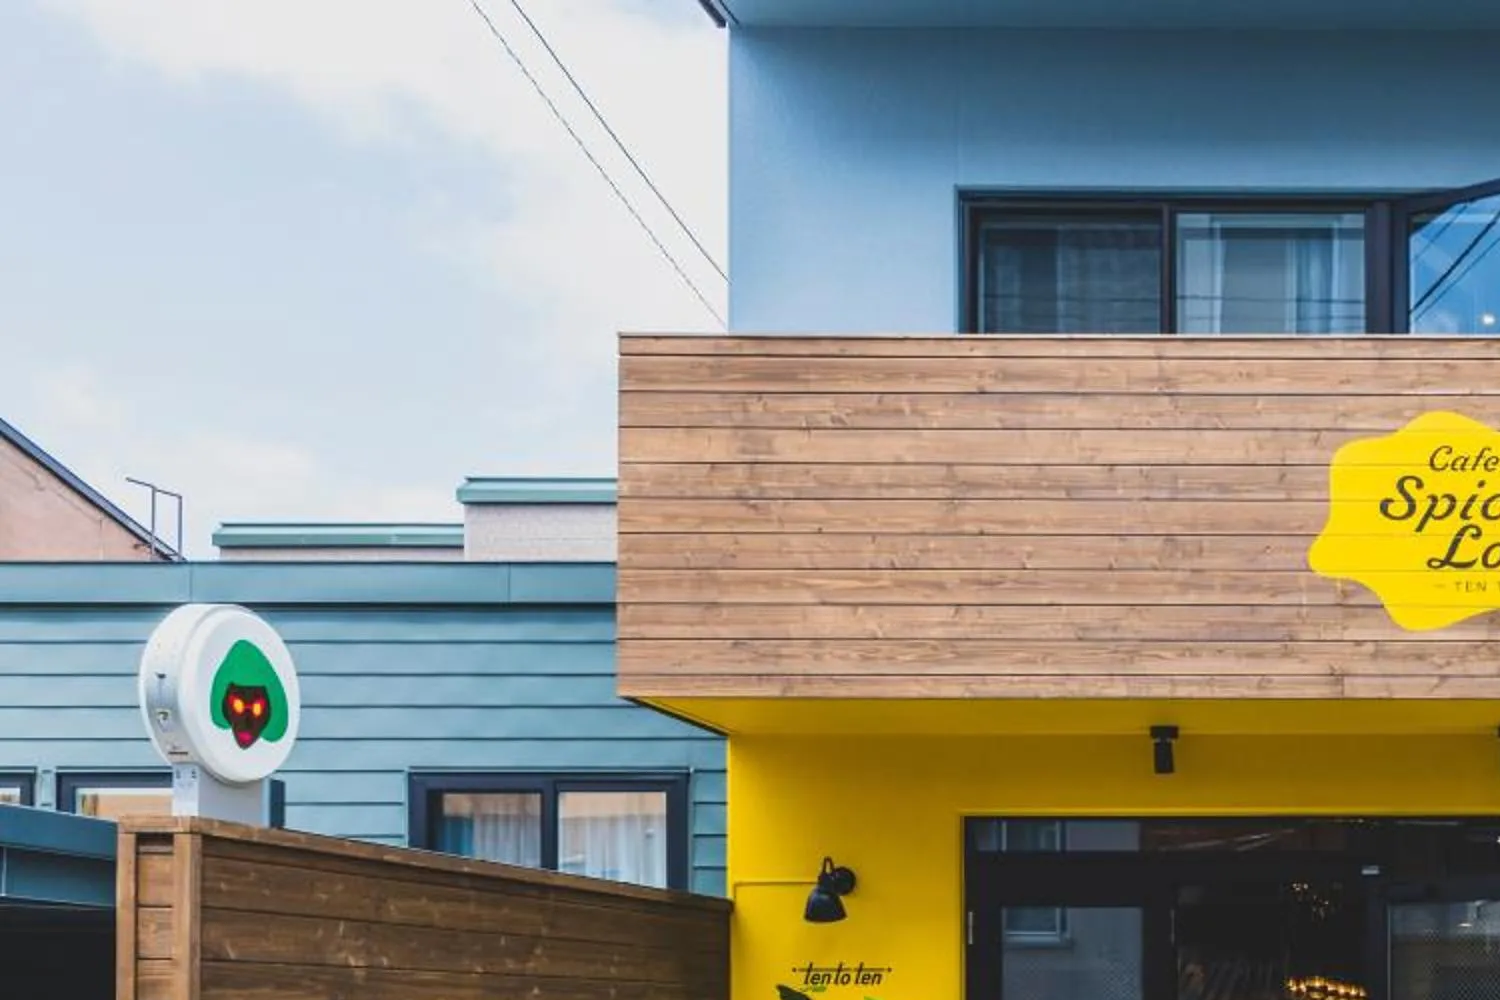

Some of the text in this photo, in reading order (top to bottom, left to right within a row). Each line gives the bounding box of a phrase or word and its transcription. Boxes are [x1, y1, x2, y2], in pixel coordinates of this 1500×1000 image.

[1428, 445, 1500, 473] Cafe
[1455, 580, 1487, 592] TEN
[804, 962, 882, 985] ten to ten
